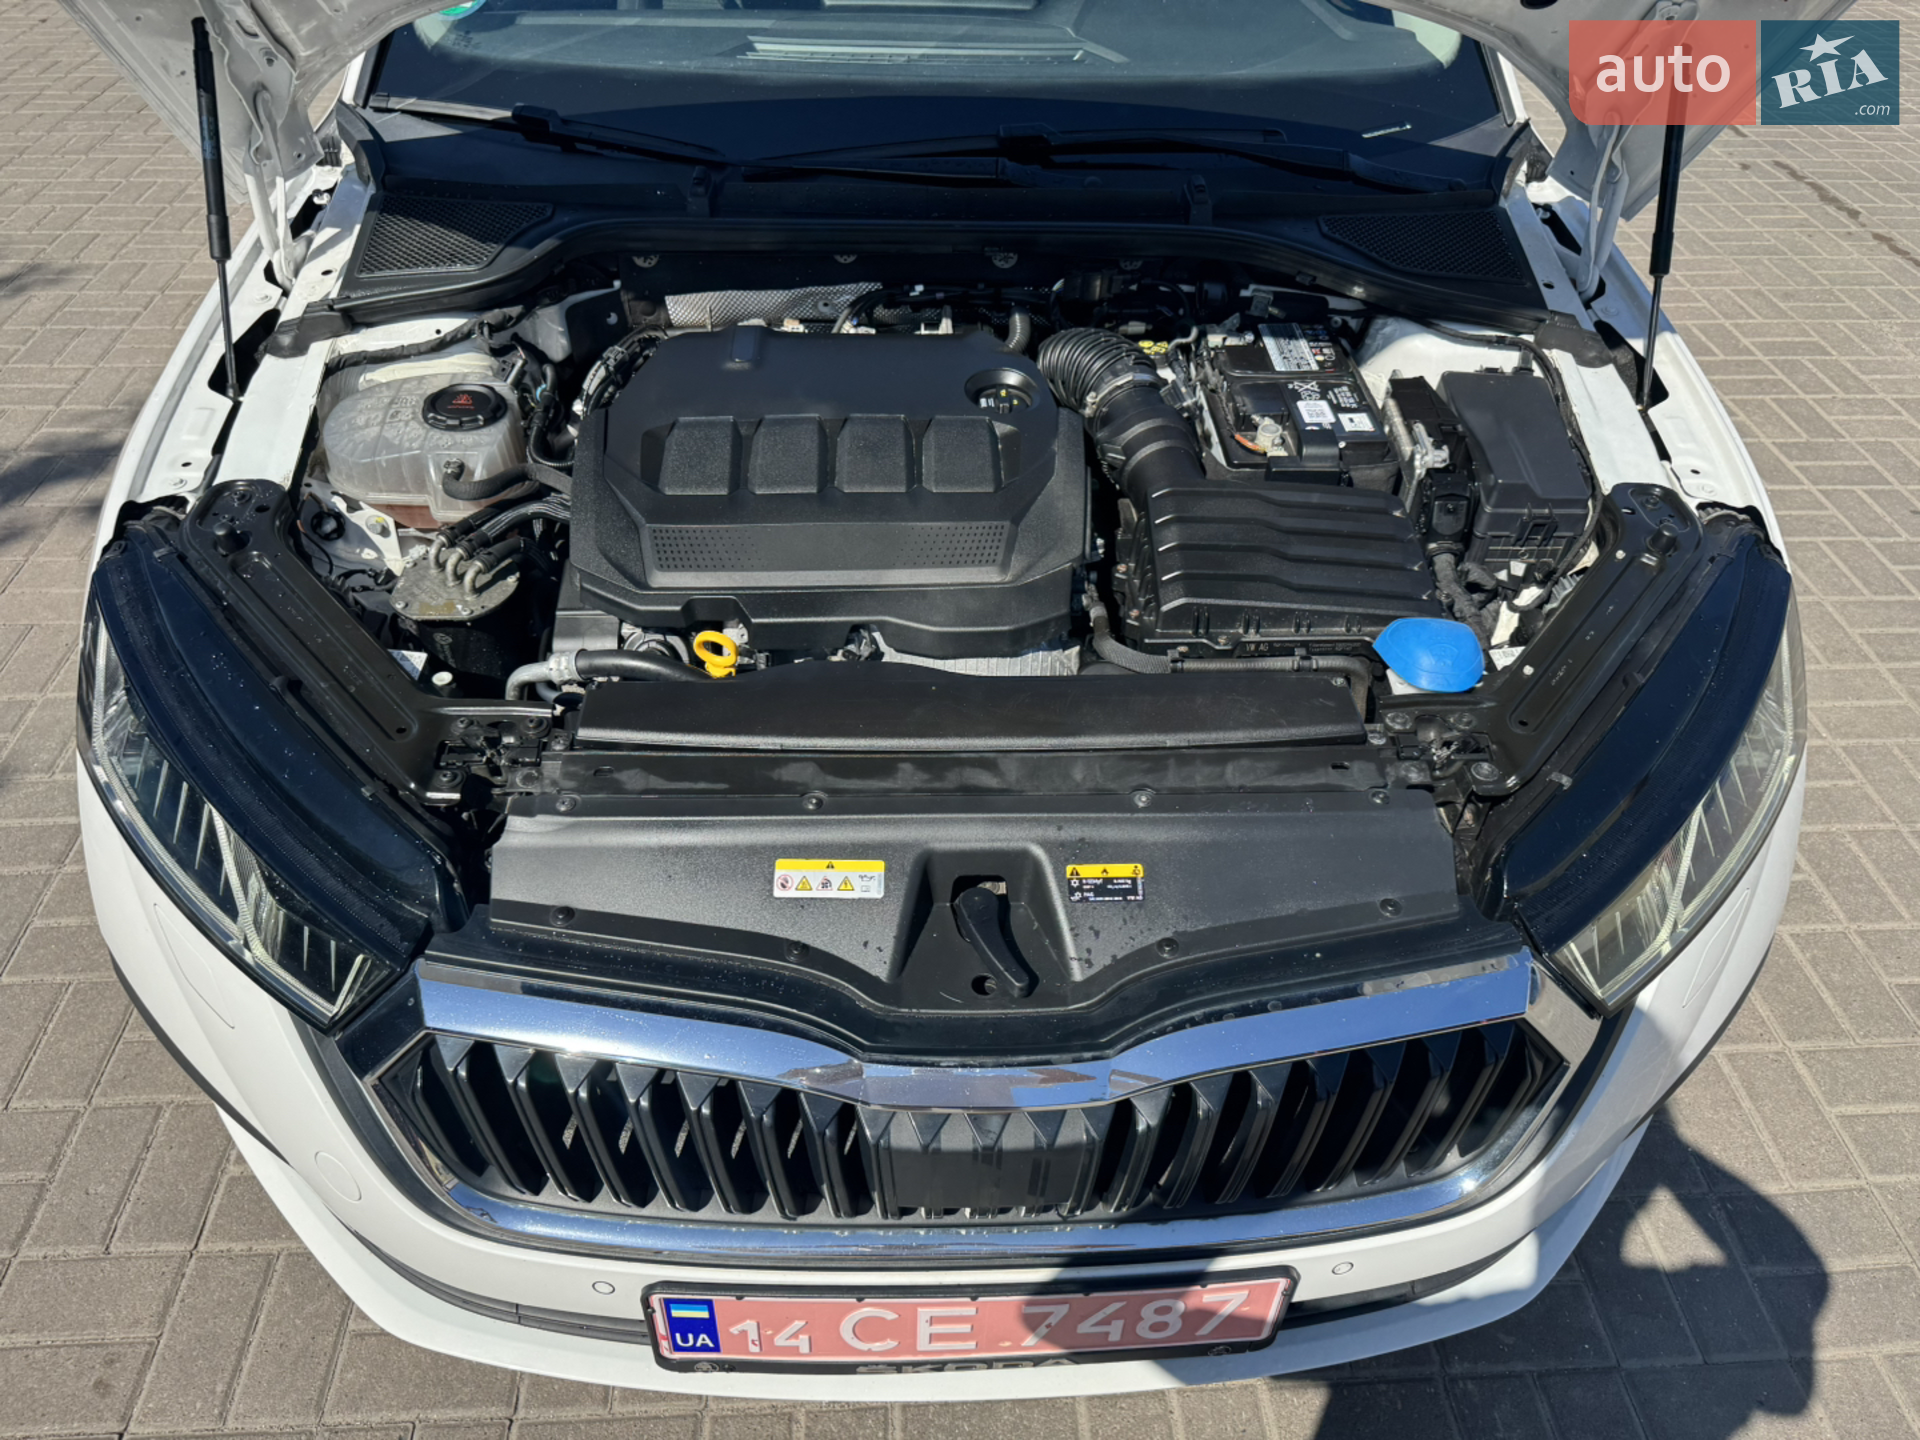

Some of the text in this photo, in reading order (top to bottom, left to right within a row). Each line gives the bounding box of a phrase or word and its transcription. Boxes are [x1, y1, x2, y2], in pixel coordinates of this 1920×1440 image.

[675, 1332, 715, 1348] UA
[729, 1290, 1250, 1354] 14 CE 7487
